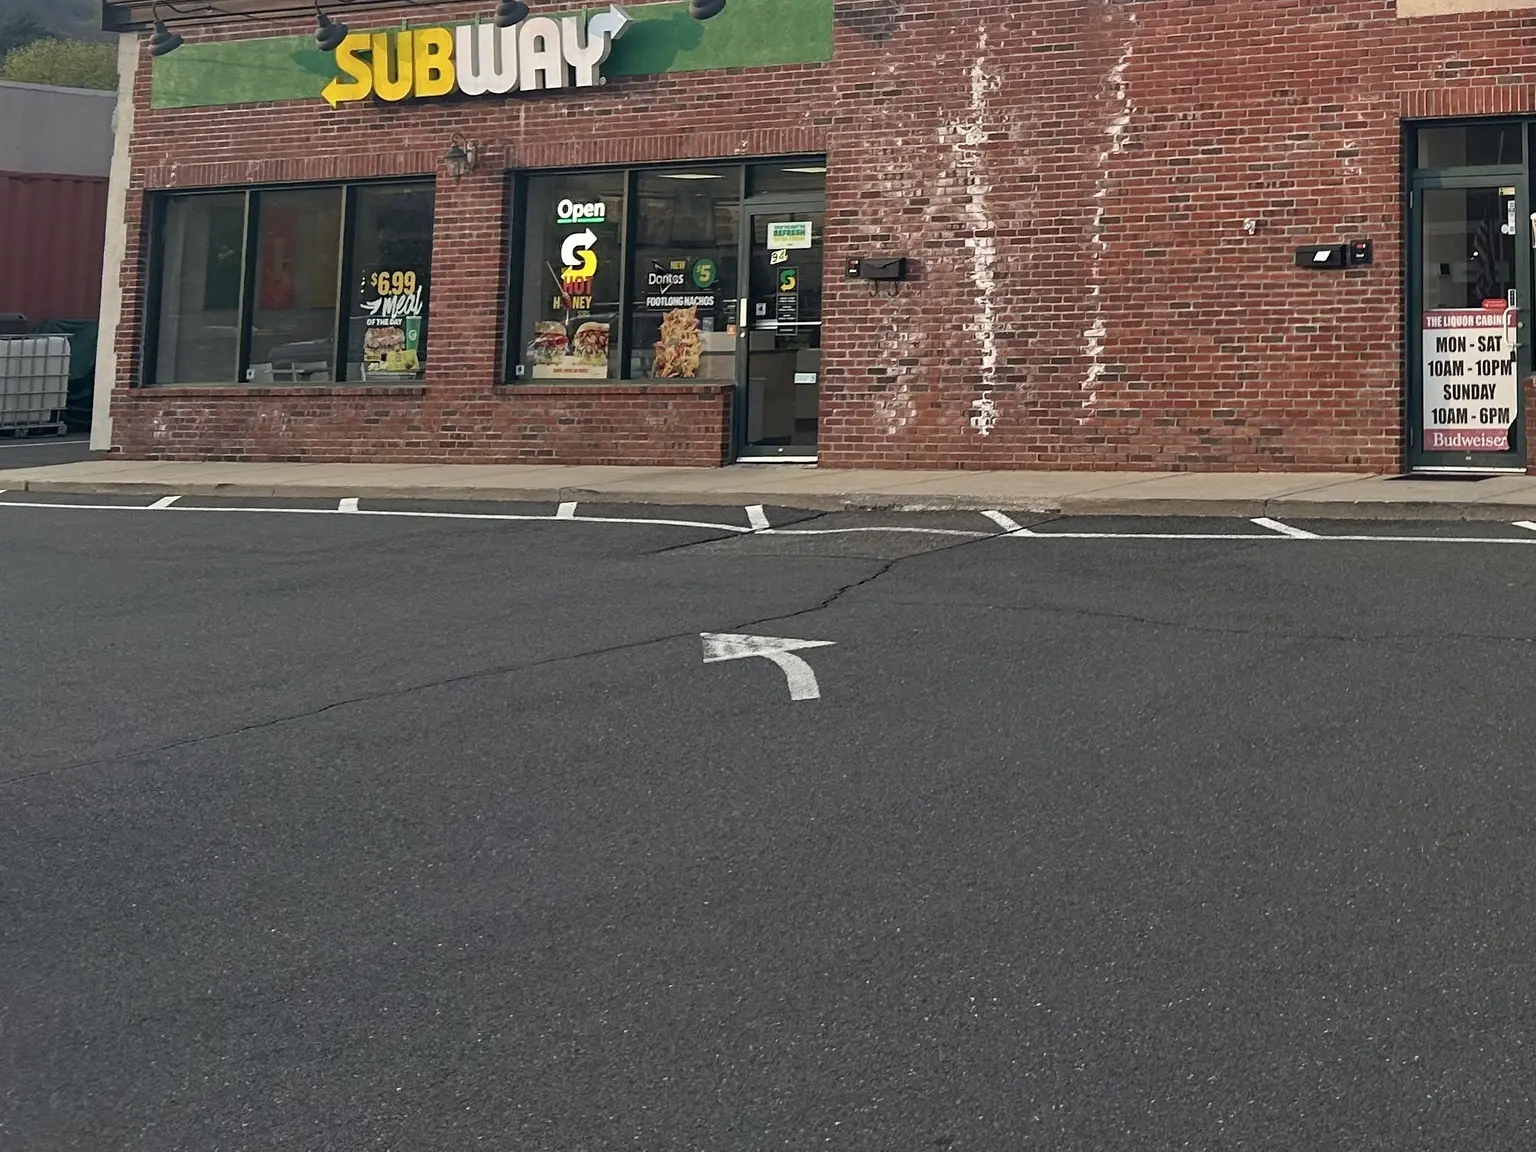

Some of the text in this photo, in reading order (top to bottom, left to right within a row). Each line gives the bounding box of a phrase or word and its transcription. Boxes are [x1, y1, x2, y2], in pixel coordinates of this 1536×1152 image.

[321, 4, 632, 109] SUBWAY
[557, 198, 606, 223] Open
[648, 273, 684, 285] Doritos
[696, 264, 711, 282] $5
[370, 270, 416, 296] $6.99
[562, 275, 594, 295] HOT
[382, 284, 423, 319] meal
[553, 296, 592, 309] HNEY
[646, 296, 715, 307] FOOTLONG NACHOS
[366, 318, 376, 326] OF
[1426, 314, 1512, 328] THE LIQUOR CABINT
[1436, 336, 1466, 353] MON
[1477, 335, 1502, 352] SAT
[1427, 359, 1464, 377] 10AM
[1475, 358, 1512, 376] 10PM
[1443, 383, 1496, 401] SUNDAY
[1431, 407, 1468, 425] 10AM
[1479, 406, 1510, 424] 6PM
[1433, 431, 1507, 447] Budweiser
